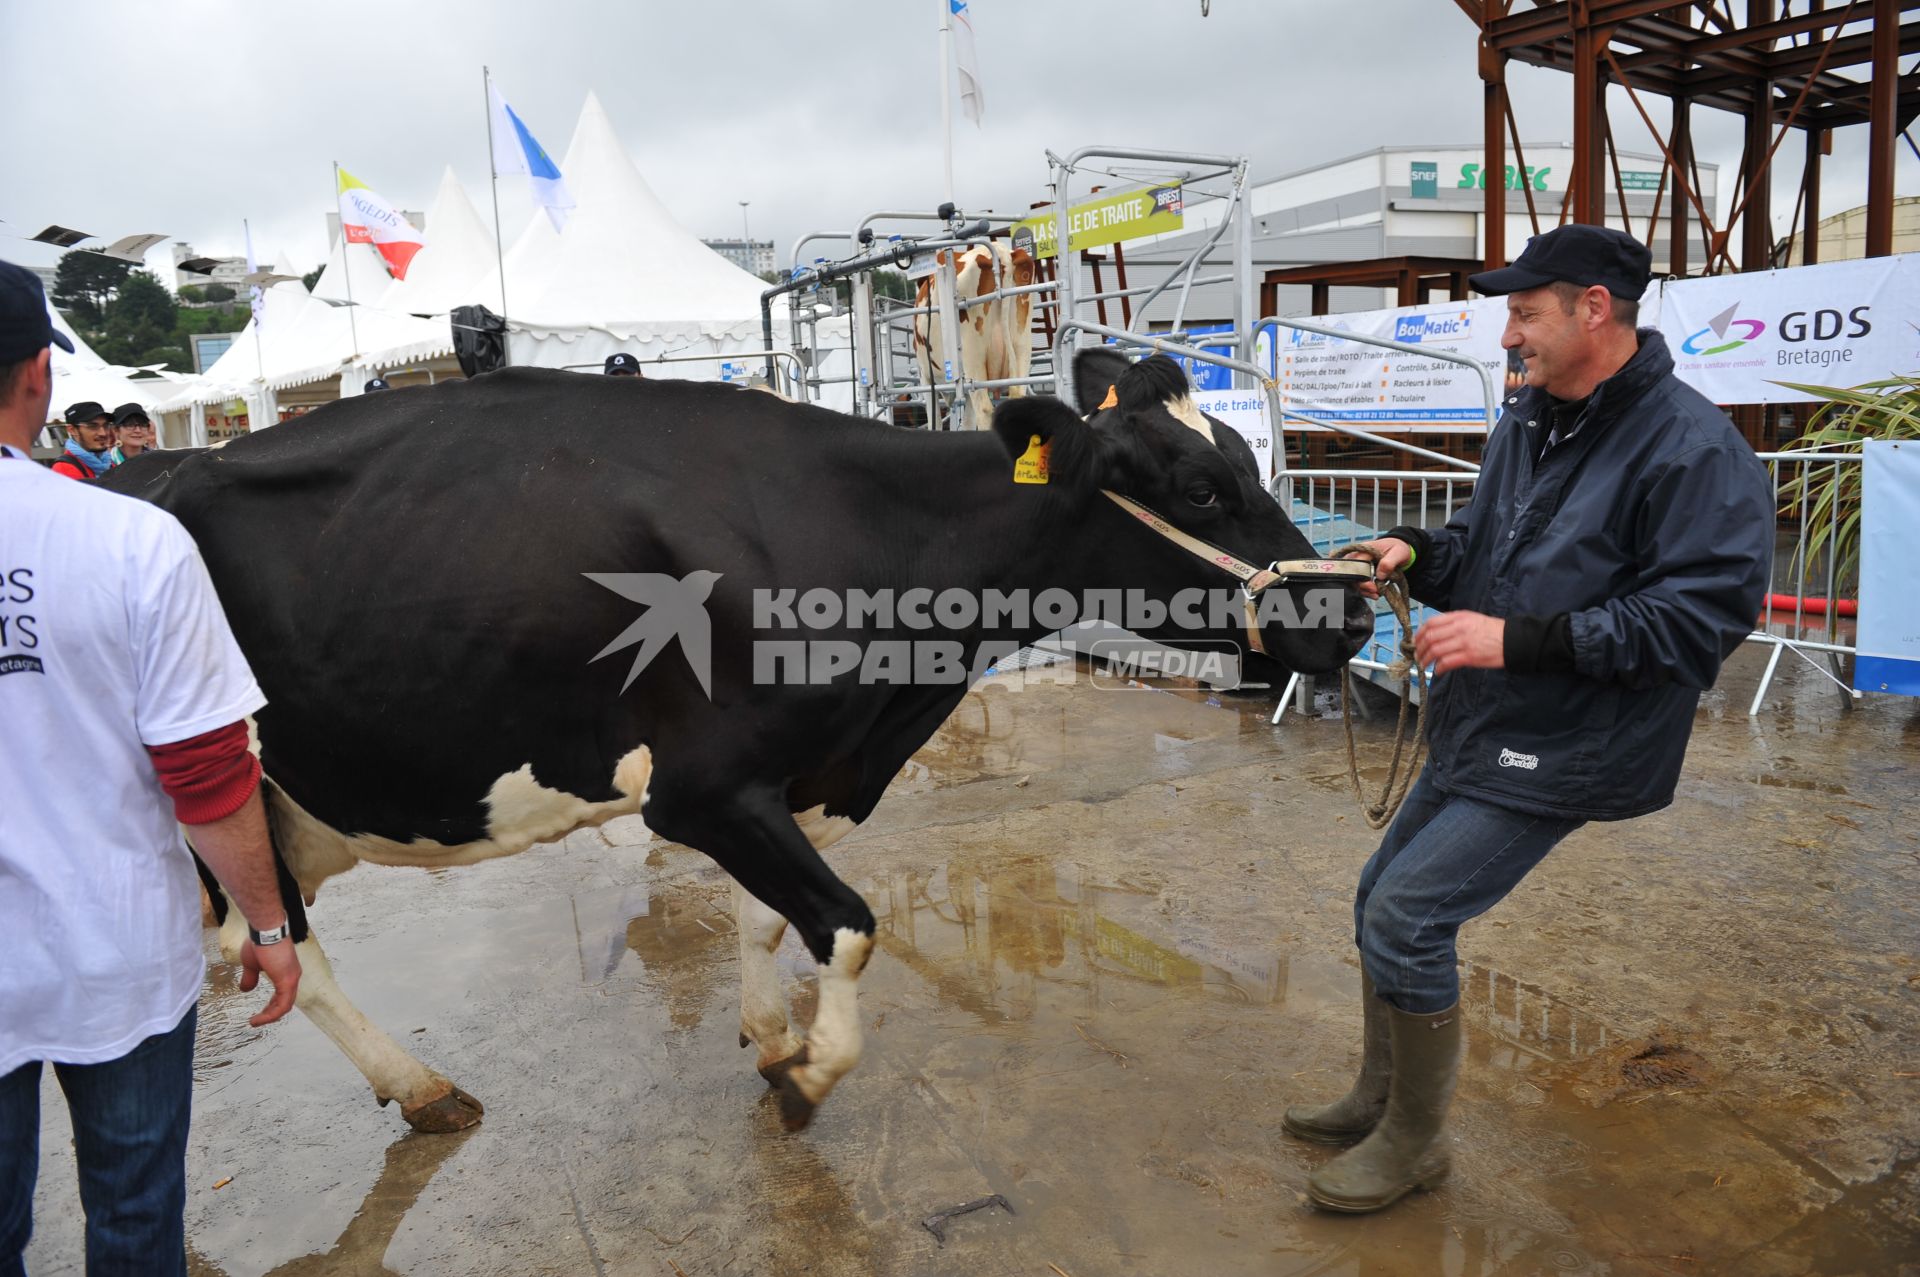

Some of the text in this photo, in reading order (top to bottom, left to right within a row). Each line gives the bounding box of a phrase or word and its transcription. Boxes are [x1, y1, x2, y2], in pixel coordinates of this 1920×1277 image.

[1458, 163, 1551, 192] SBEC
[1158, 189, 1180, 206] BREST
[1032, 224, 1047, 242] LA
[1084, 210, 1099, 231] DE
[1100, 198, 1142, 227] TRAITE
[1398, 320, 1460, 336] BouMatic
[1778, 306, 1872, 342] GDS
[1732, 359, 1766, 368] ensemble
[1777, 348, 1853, 368] Bretagne
[1432, 362, 1447, 370] SAV
[1394, 378, 1452, 388] Racleurs à lisier
[1214, 400, 1228, 412] de
[1232, 398, 1264, 411] traite
[1344, 395, 1374, 404] d'étables
[1392, 394, 1426, 402] Tubulaire
[1256, 438, 1268, 448] 30
[1153, 520, 1169, 533] GDS
[1233, 562, 1250, 576] GDS
